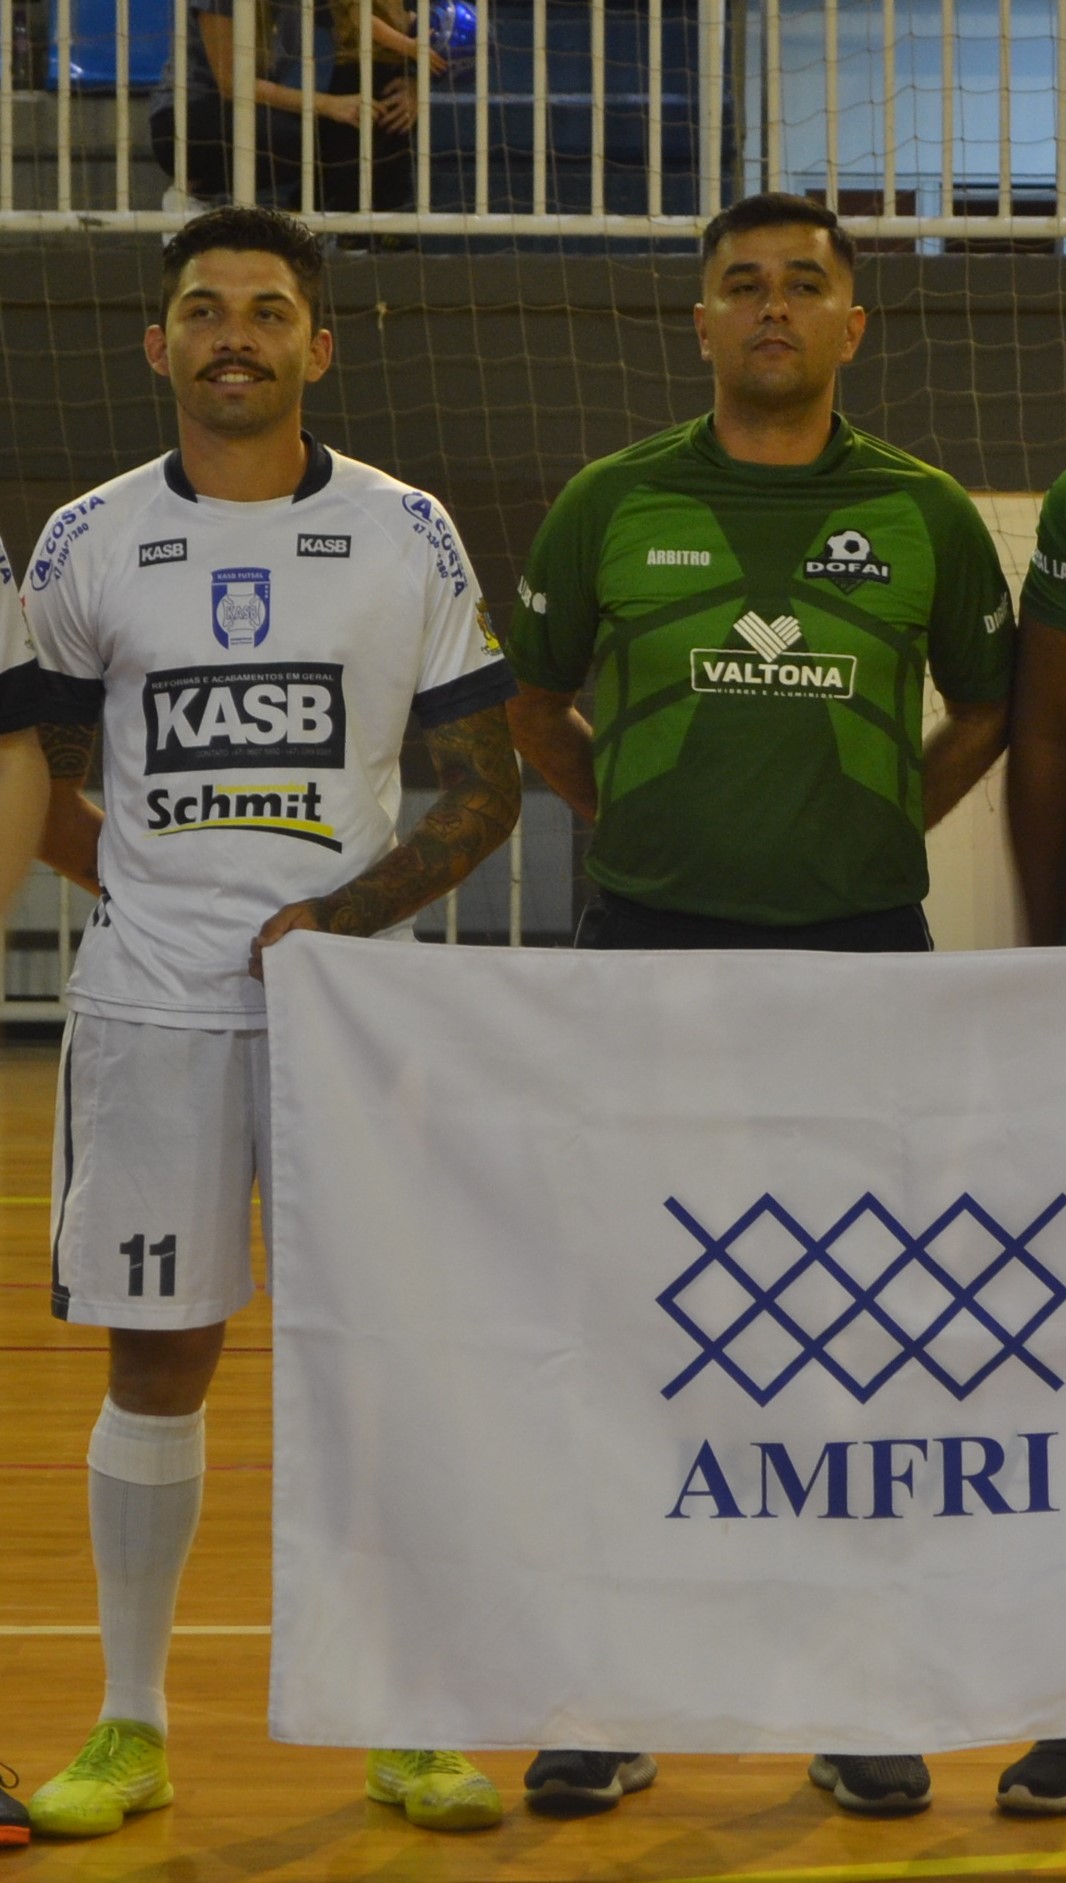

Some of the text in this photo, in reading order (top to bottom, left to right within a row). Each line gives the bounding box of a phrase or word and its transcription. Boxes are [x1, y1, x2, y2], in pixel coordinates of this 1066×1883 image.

[140, 542, 185, 563] KASB
[299, 538, 348, 554] KASB
[646, 546, 711, 567] ÁRBITRO
[805, 561, 889, 578] DOFAI
[225, 604, 259, 621] KASB
[151, 672, 334, 691] REFORMAS E ACABAMENTOS EM GERAL
[702, 660, 843, 688] VALTONA
[153, 683, 333, 751] KASB
[146, 781, 322, 830] Schmit
[119, 1233, 177, 1297] 11
[664, 1431, 1061, 1519] AMFRI
